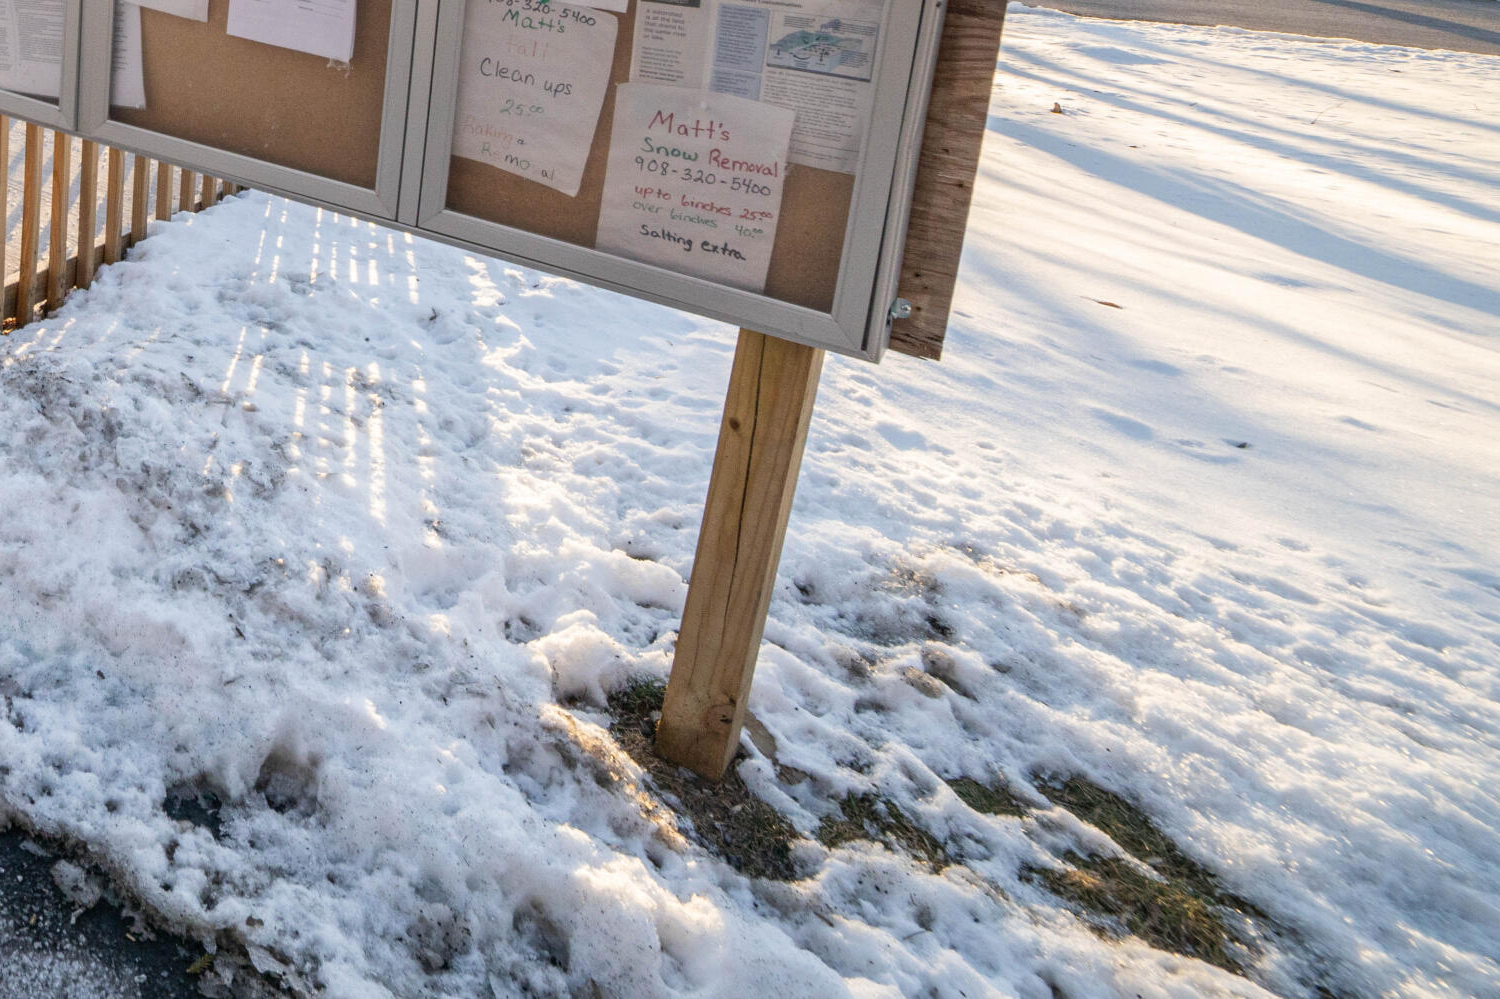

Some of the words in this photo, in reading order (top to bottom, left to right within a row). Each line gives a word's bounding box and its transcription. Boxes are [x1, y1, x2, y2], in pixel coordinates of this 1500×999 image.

[501, 8, 566, 34] Matt's
[480, 57, 535, 86] Clean
[543, 79, 573, 98] ups
[648, 109, 730, 142] Matt's
[634, 155, 772, 197] 908-320-5400
[641, 136, 699, 162] Snow
[708, 148, 778, 178] Removal
[632, 200, 663, 214] over
[639, 223, 693, 252] Salting
[701, 240, 747, 261] extra
